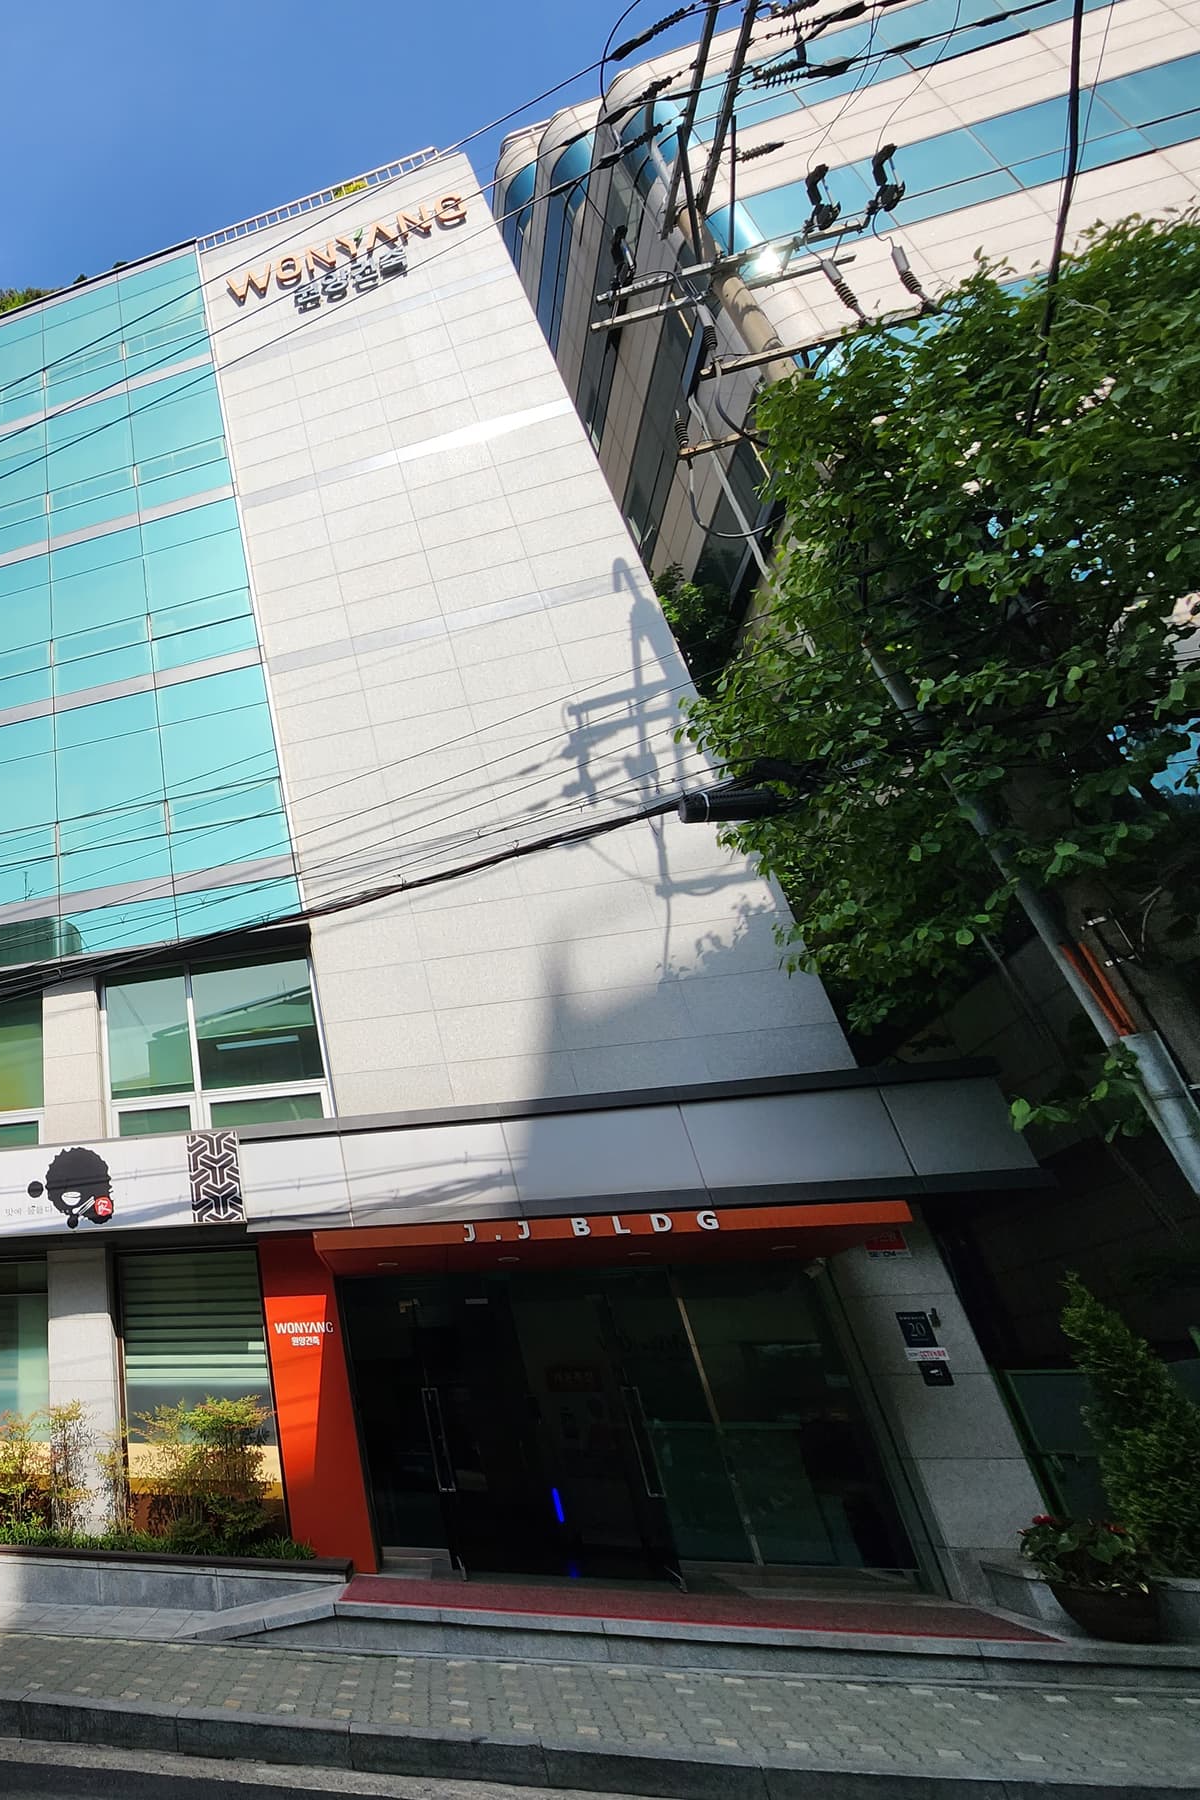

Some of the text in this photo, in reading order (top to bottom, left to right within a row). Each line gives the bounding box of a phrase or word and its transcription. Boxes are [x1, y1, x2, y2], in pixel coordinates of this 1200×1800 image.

[226, 192, 467, 302] WONYANG
[294, 246, 408, 310] 원양건축
[570, 1210, 720, 1237] BLDG
[274, 1321, 334, 1334] WONYANG
[908, 1322, 927, 1337] 20
[291, 1335, 320, 1346] 원양건축
